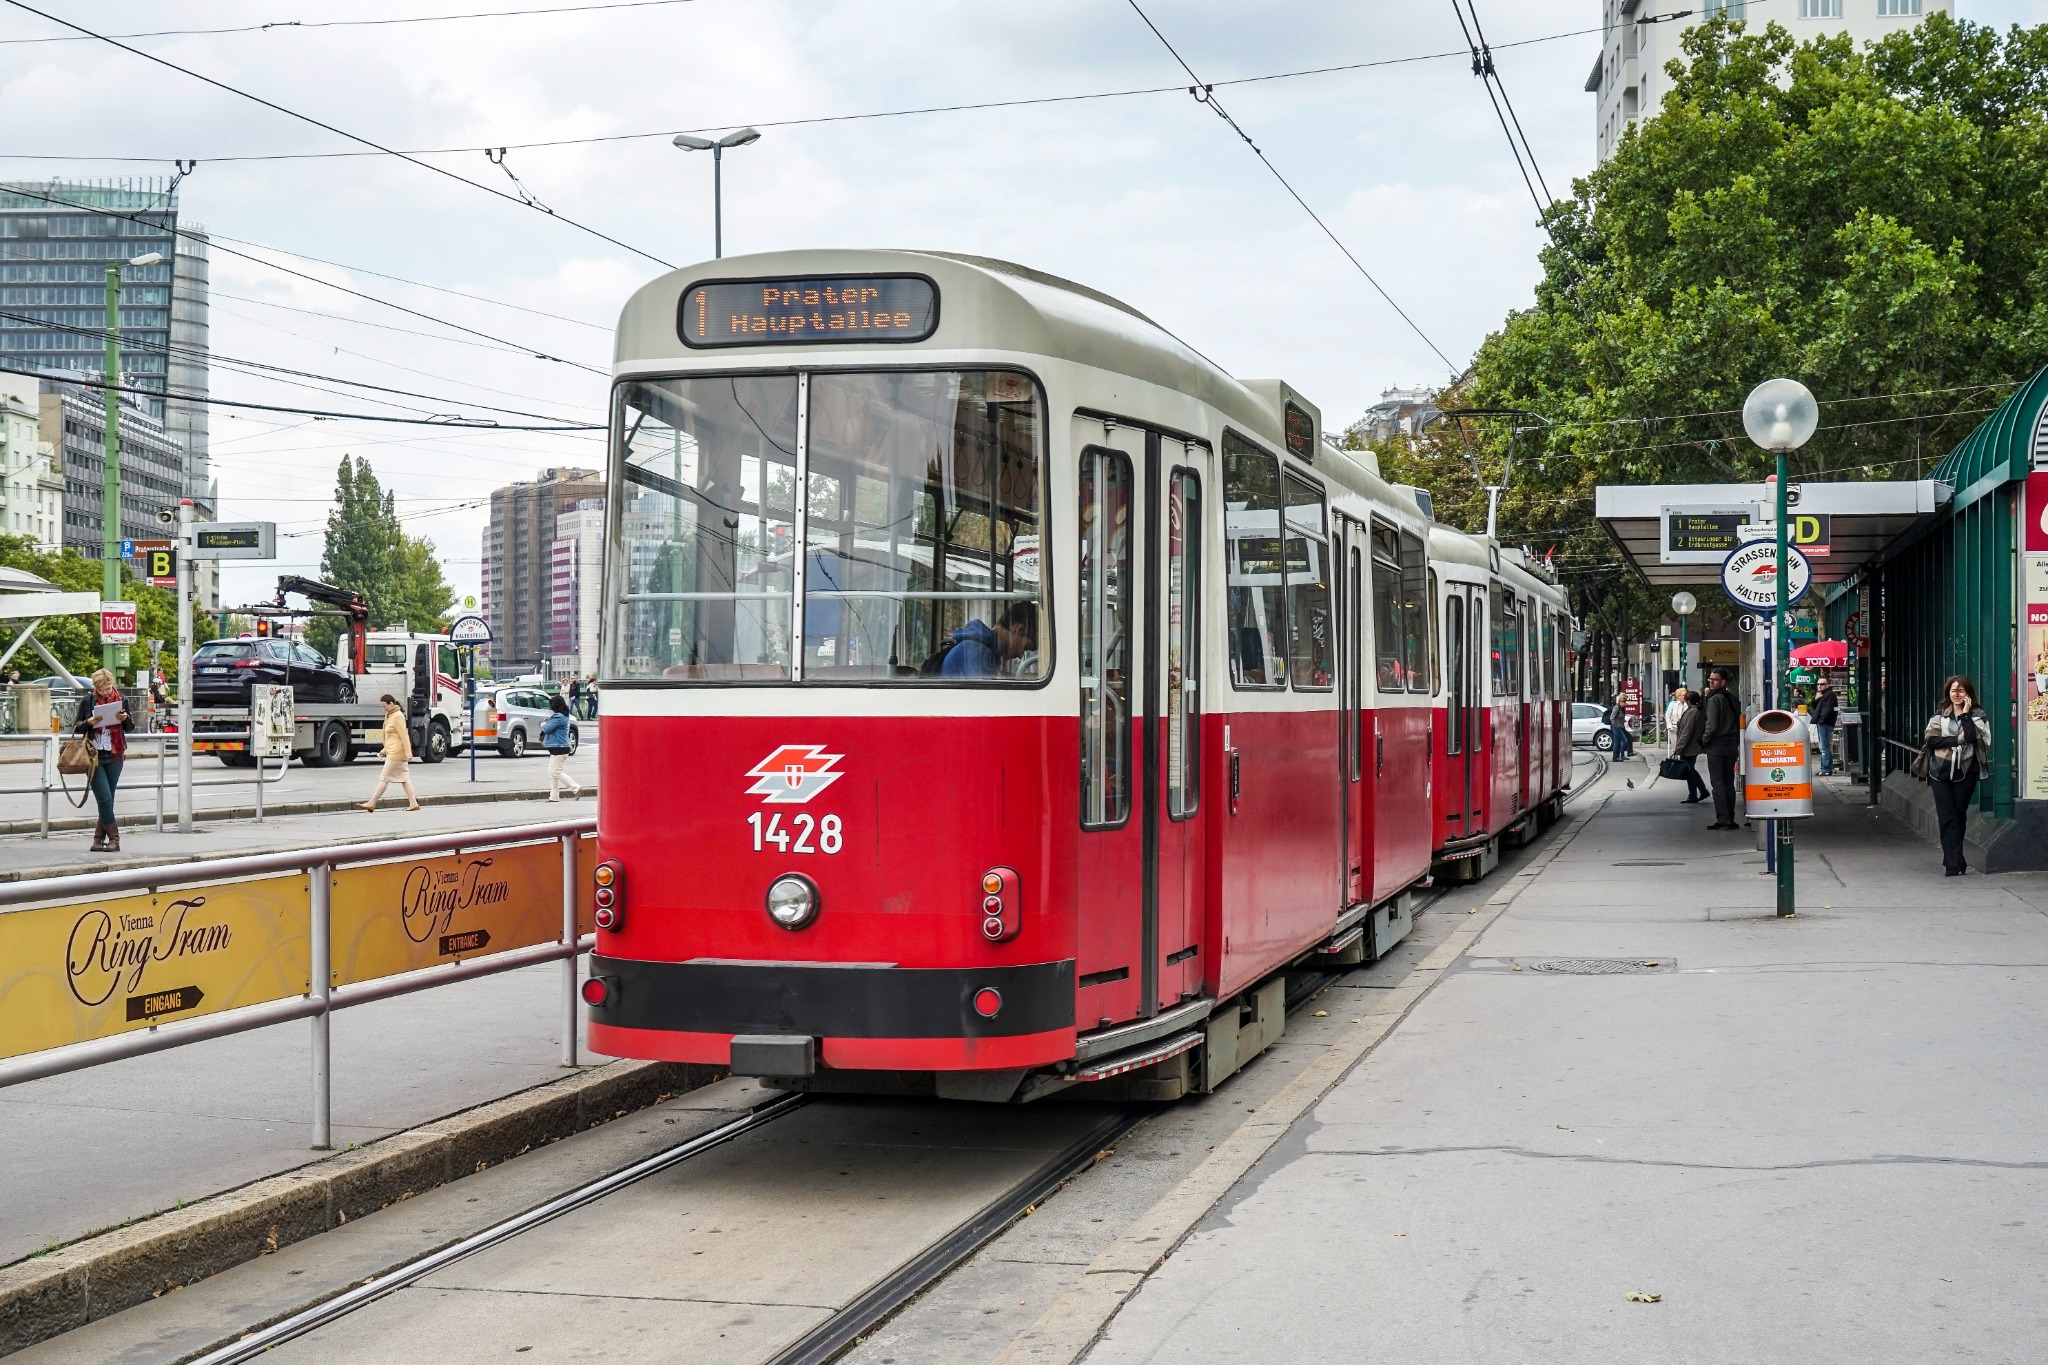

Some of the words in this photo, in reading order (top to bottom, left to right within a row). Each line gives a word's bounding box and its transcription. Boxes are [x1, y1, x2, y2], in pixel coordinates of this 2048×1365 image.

[696, 292, 705, 336] 1
[763, 287, 878, 306] Prater
[731, 311, 911, 333] Hauptallee
[1678, 519, 1681, 528] 1
[1796, 517, 1820, 543] D
[1678, 537, 1683, 546] 2
[154, 553, 169, 575] B
[1731, 548, 1801, 573] STRASSENHN
[1736, 582, 1799, 603] HALTESTLE
[105, 617, 132, 630] TICKETS
[460, 620, 482, 628] AUTOBUS
[1847, 616, 1863, 646] TRAFIK
[746, 811, 843, 855] 1428
[436, 870, 458, 884] Vienna
[402, 866, 458, 942] Ring
[458, 858, 510, 909] Tram
[119, 914, 153, 932] Vienna
[66, 910, 153, 1006] Ring
[153, 897, 232, 961] Tram
[449, 934, 479, 951] ENTRANCE
[145, 992, 181, 1014] EINGANG
